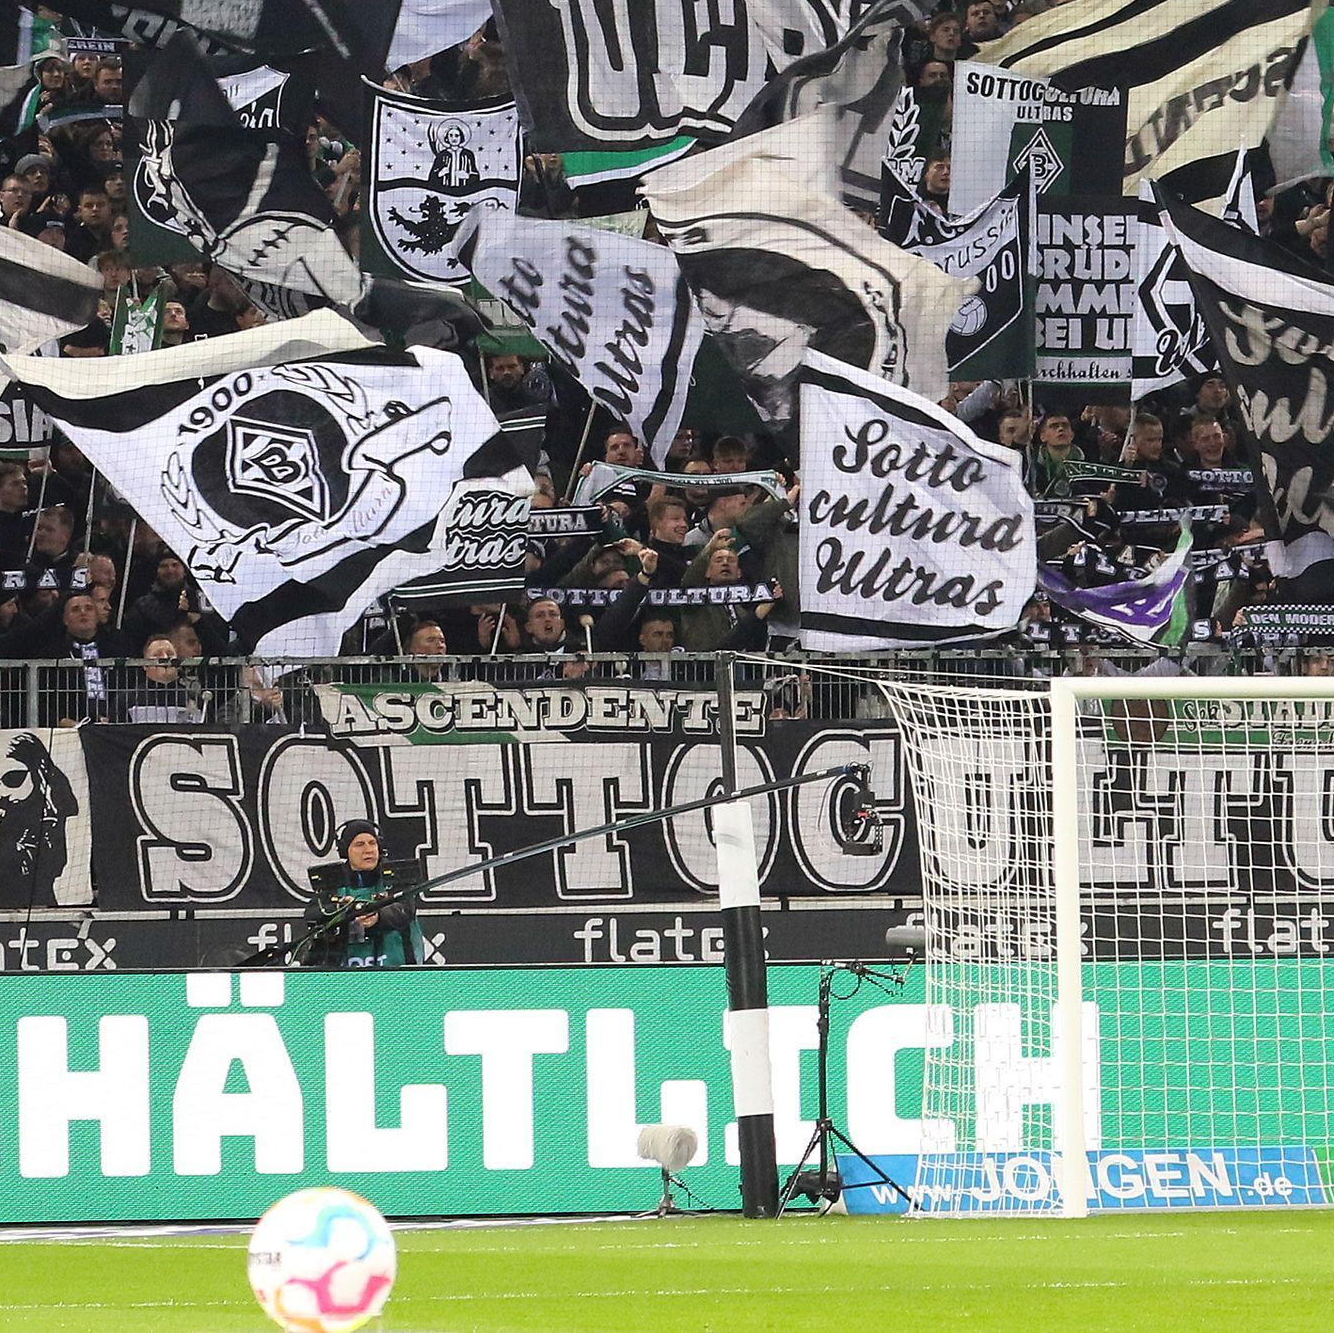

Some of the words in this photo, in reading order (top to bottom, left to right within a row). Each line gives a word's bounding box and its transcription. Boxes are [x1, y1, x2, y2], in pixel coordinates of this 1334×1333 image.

[1014, 102, 1075, 126] ULTRAS
[179, 368, 255, 438] 1900
[833, 416, 987, 496] Sotto
[1188, 469, 1255, 485] SOTTO
[807, 480, 1021, 556] cultura
[813, 536, 1007, 615] Ultras
[1249, 612, 1281, 627] DEN
[1247, 1173, 1294, 1198] .de
